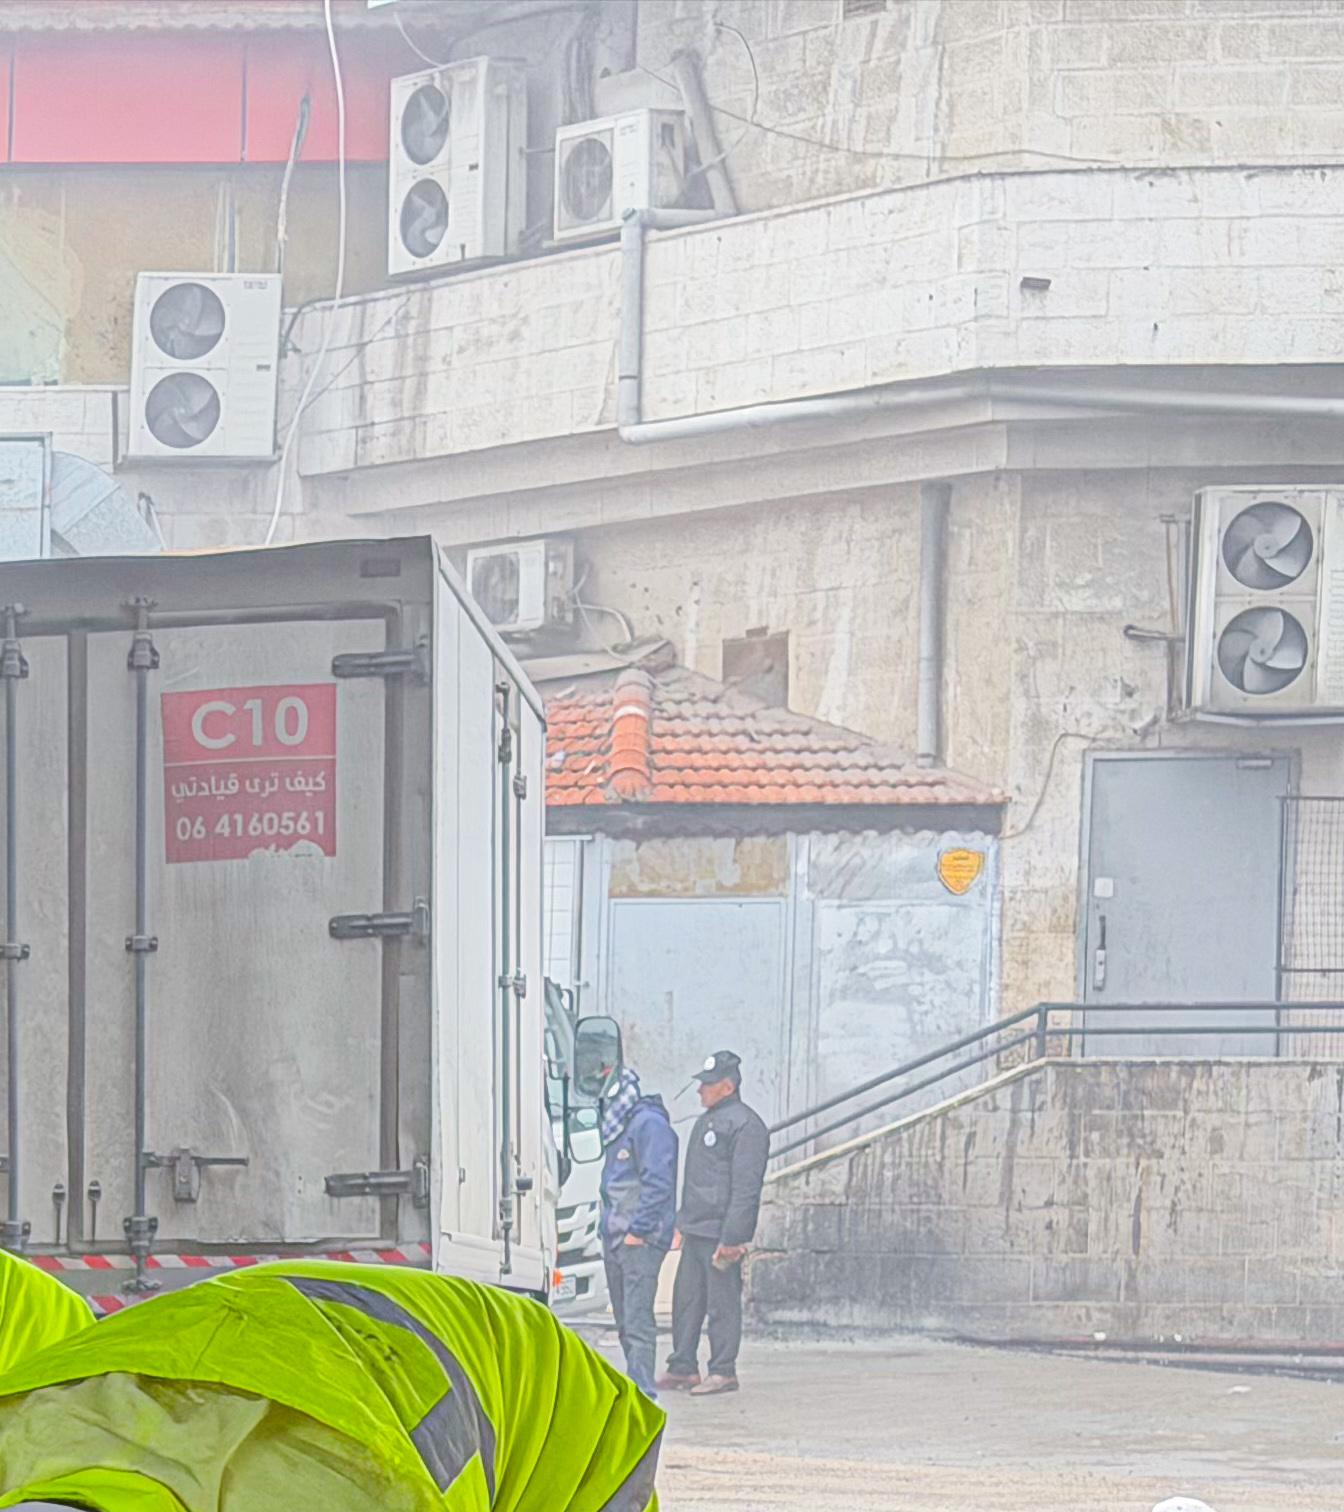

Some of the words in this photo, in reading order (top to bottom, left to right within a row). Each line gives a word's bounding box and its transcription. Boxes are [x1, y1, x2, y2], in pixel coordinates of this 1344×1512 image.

[191, 696, 309, 750] C10
[171, 773, 240, 803] قيادتي
[245, 772, 279, 798] ترى
[285, 770, 327, 796] كيف
[176, 817, 205, 841] 06
[215, 811, 326, 837] 4160561
